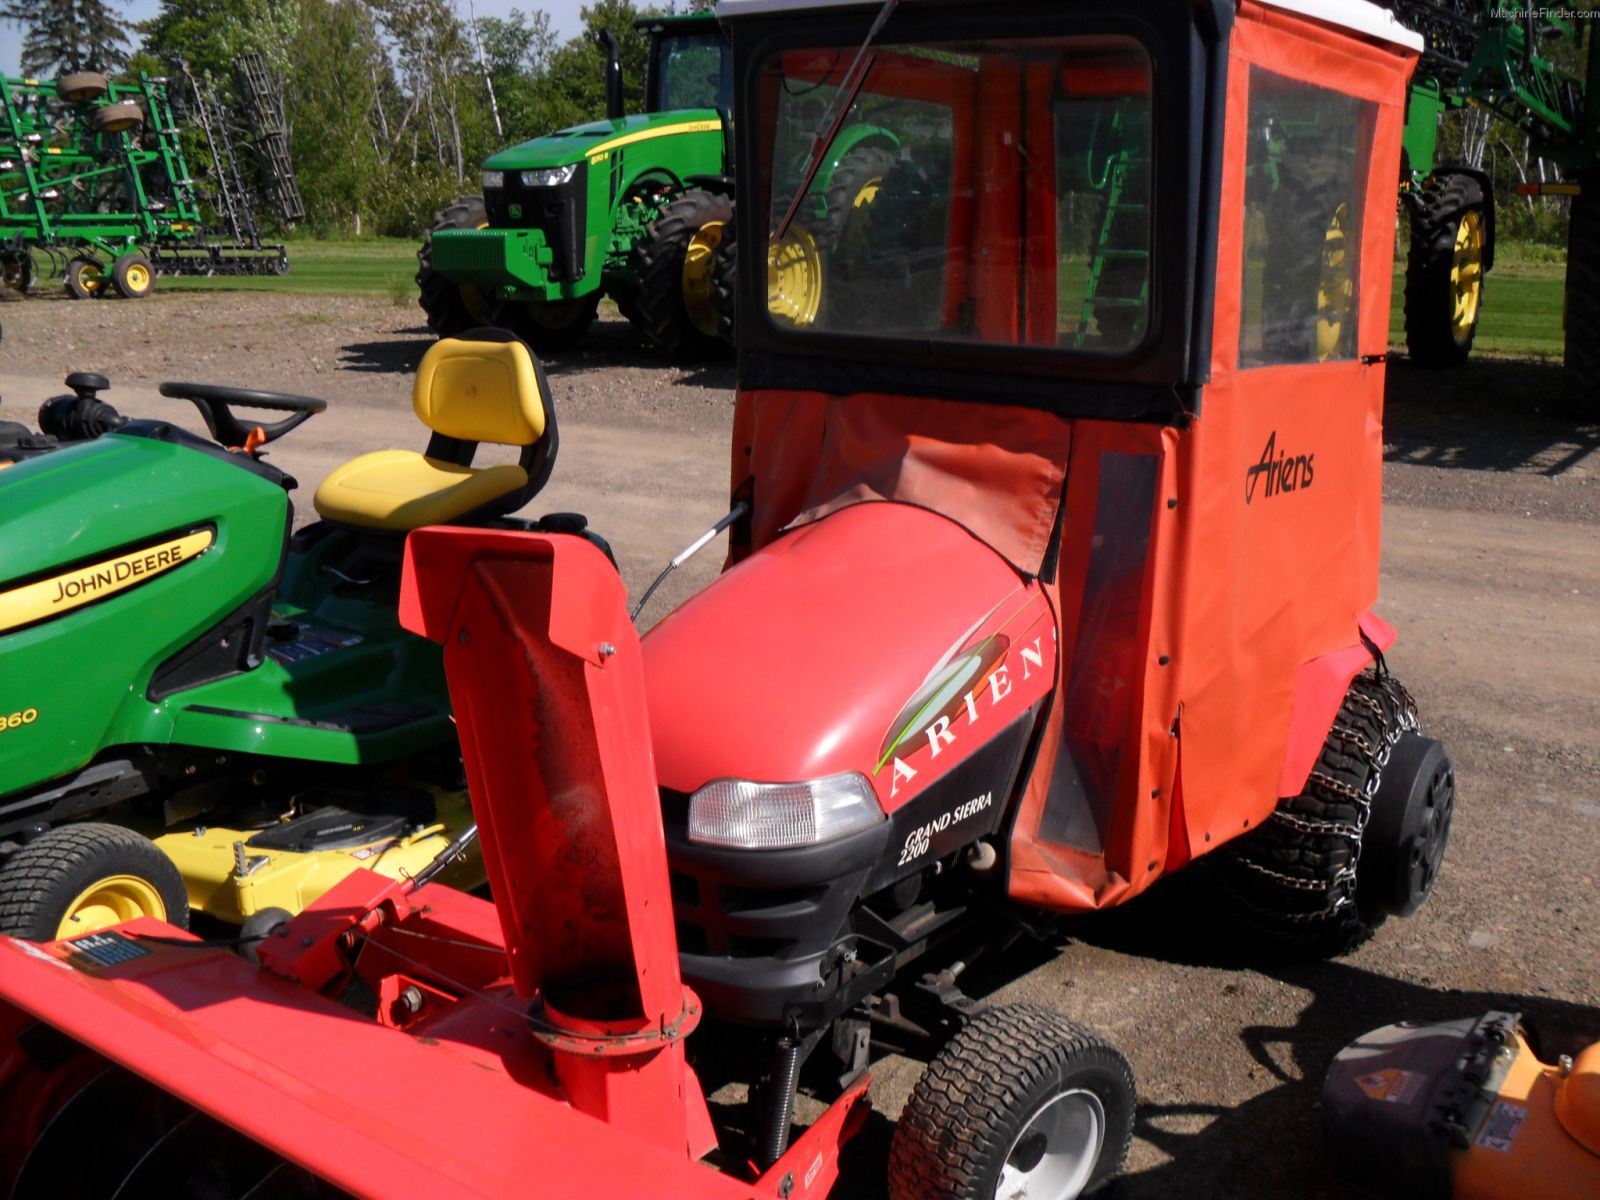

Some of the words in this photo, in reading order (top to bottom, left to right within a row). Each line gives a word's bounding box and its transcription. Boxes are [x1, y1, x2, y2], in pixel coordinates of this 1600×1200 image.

[1246, 430, 1314, 505] Ariens
[53, 570, 112, 603] JOHN
[114, 545, 182, 582] DEERE
[890, 626, 1057, 798] ARIEN
[905, 812, 951, 848] GRAND
[952, 792, 992, 824] SIERRA
[898, 838, 929, 866] 2200
